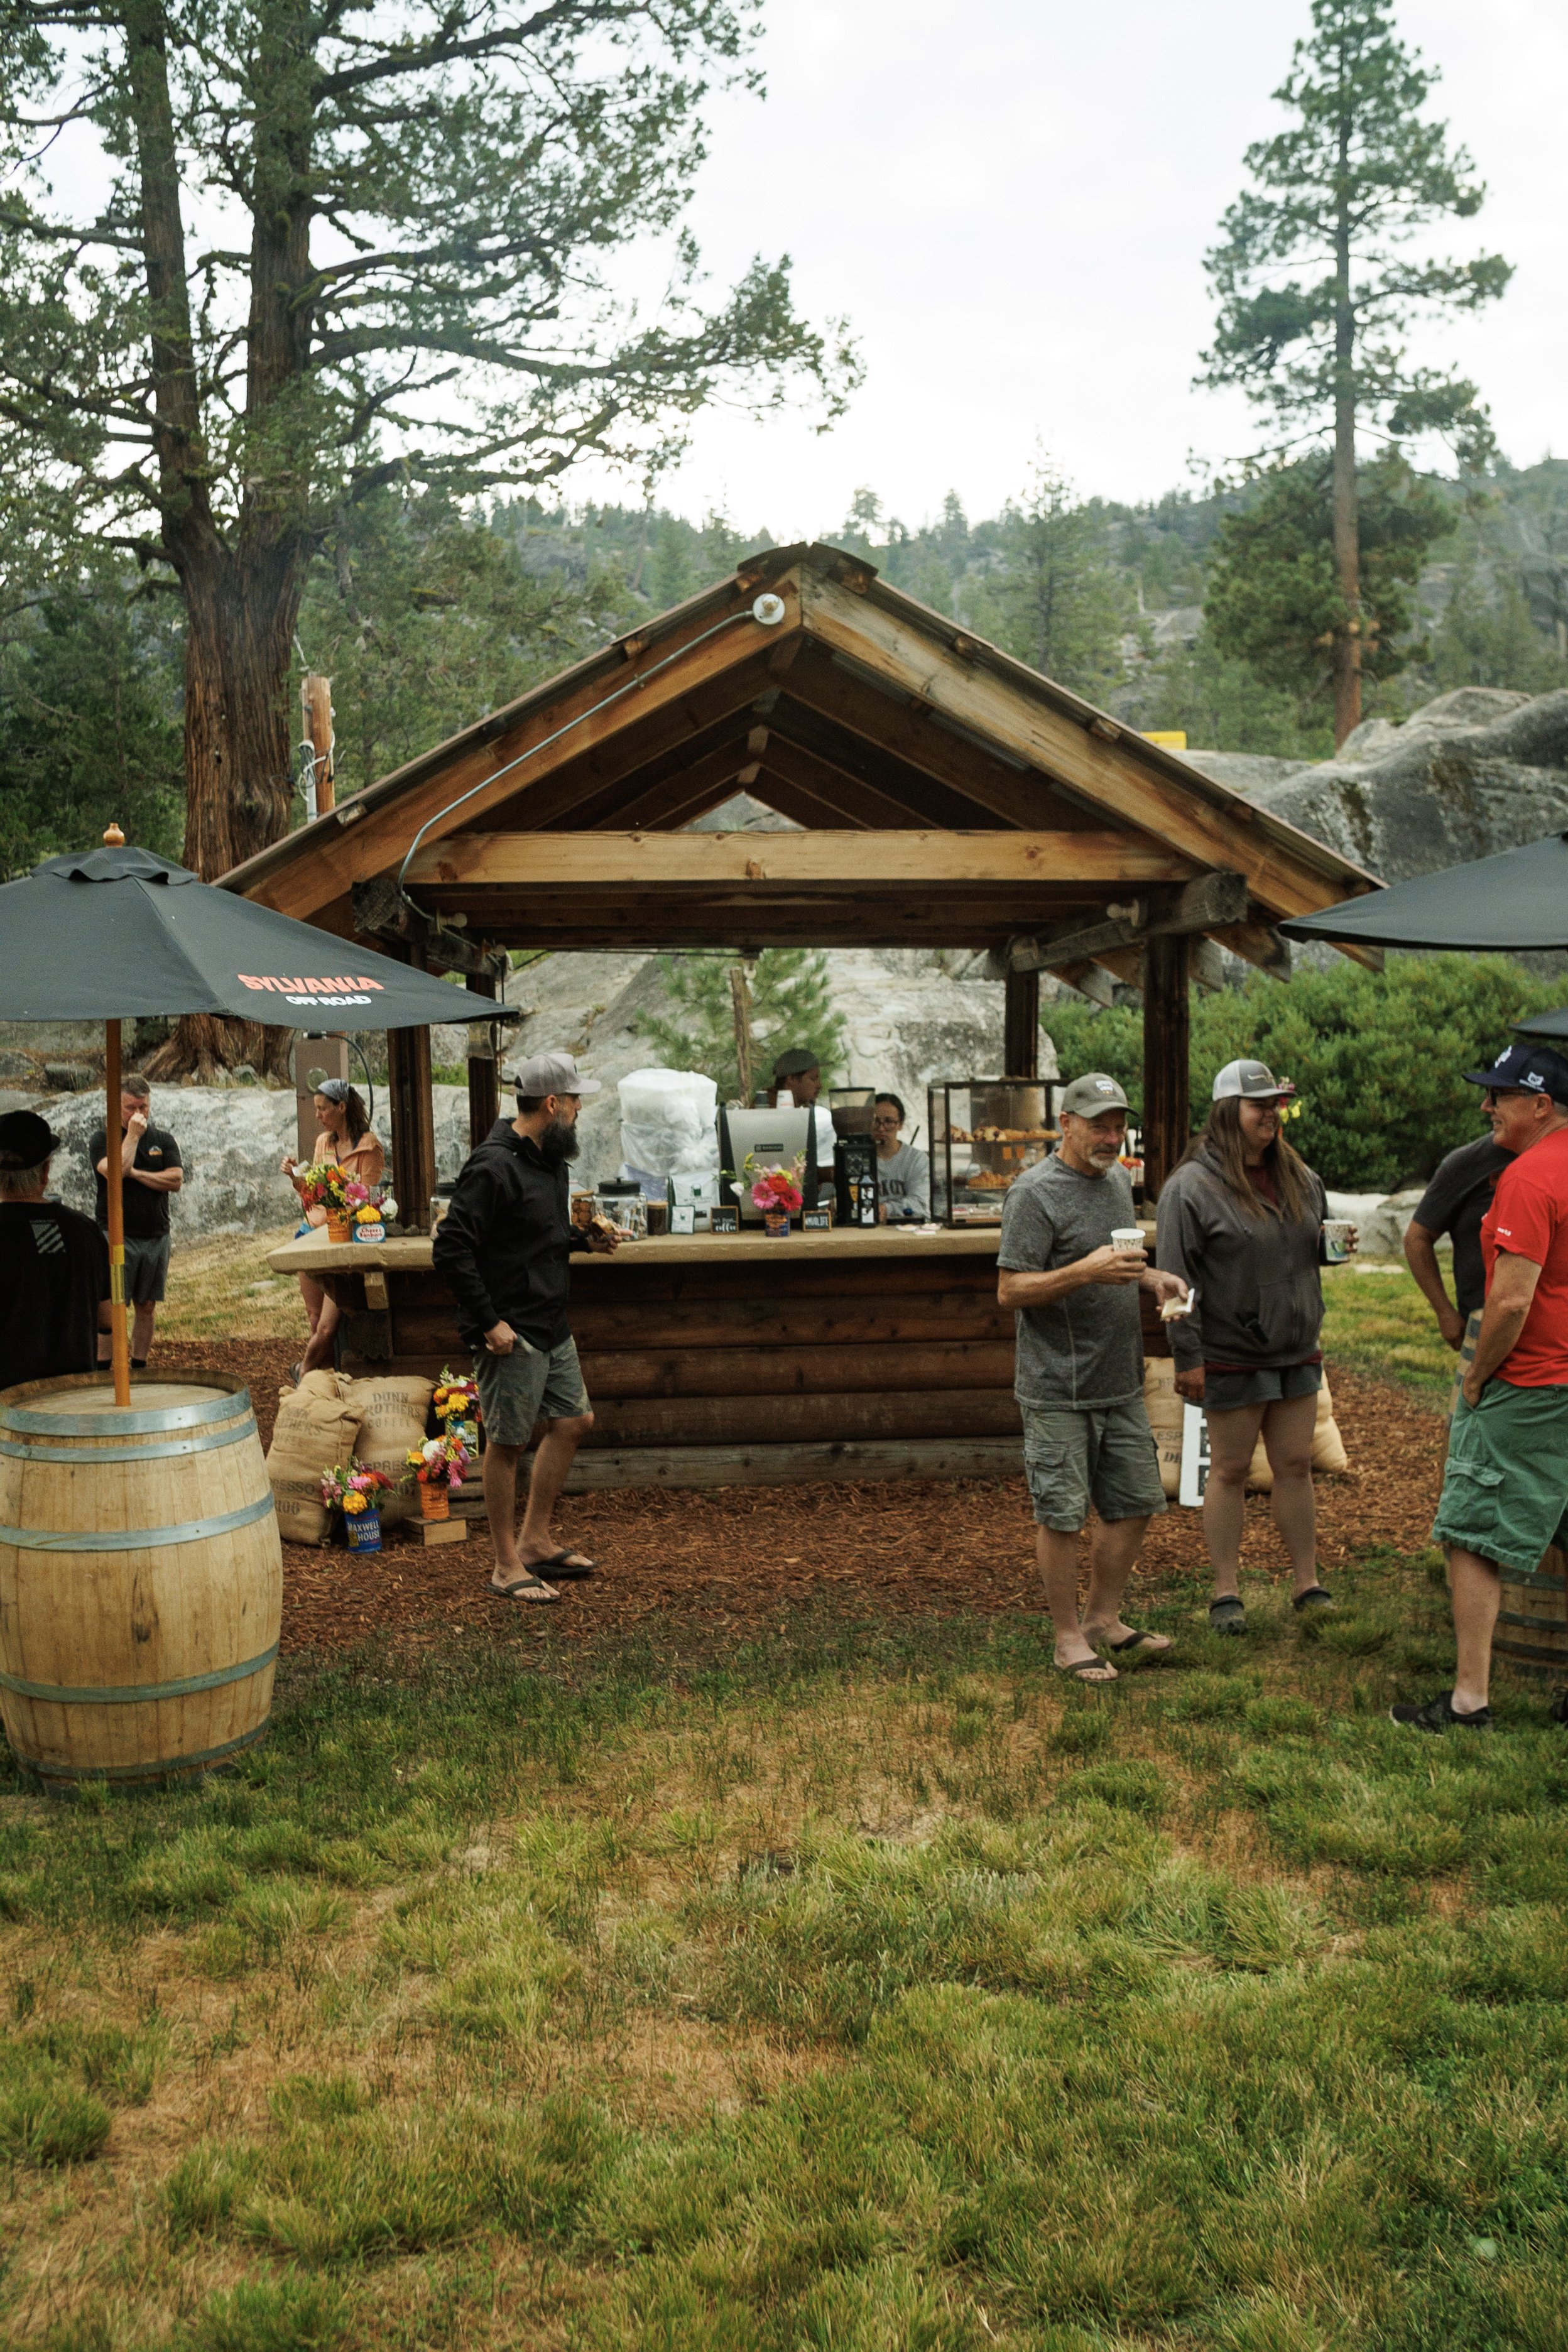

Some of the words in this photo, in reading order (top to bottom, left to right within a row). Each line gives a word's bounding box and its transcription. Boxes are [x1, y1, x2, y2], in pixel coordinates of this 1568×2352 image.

[237, 974, 384, 993] SYLVANIA
[317, 995, 372, 1006] ROAD
[373, 1391, 409, 1403] DUNN
[366, 1403, 421, 1418] ROTHERS
[347, 1520, 379, 1532] MAXWELL
